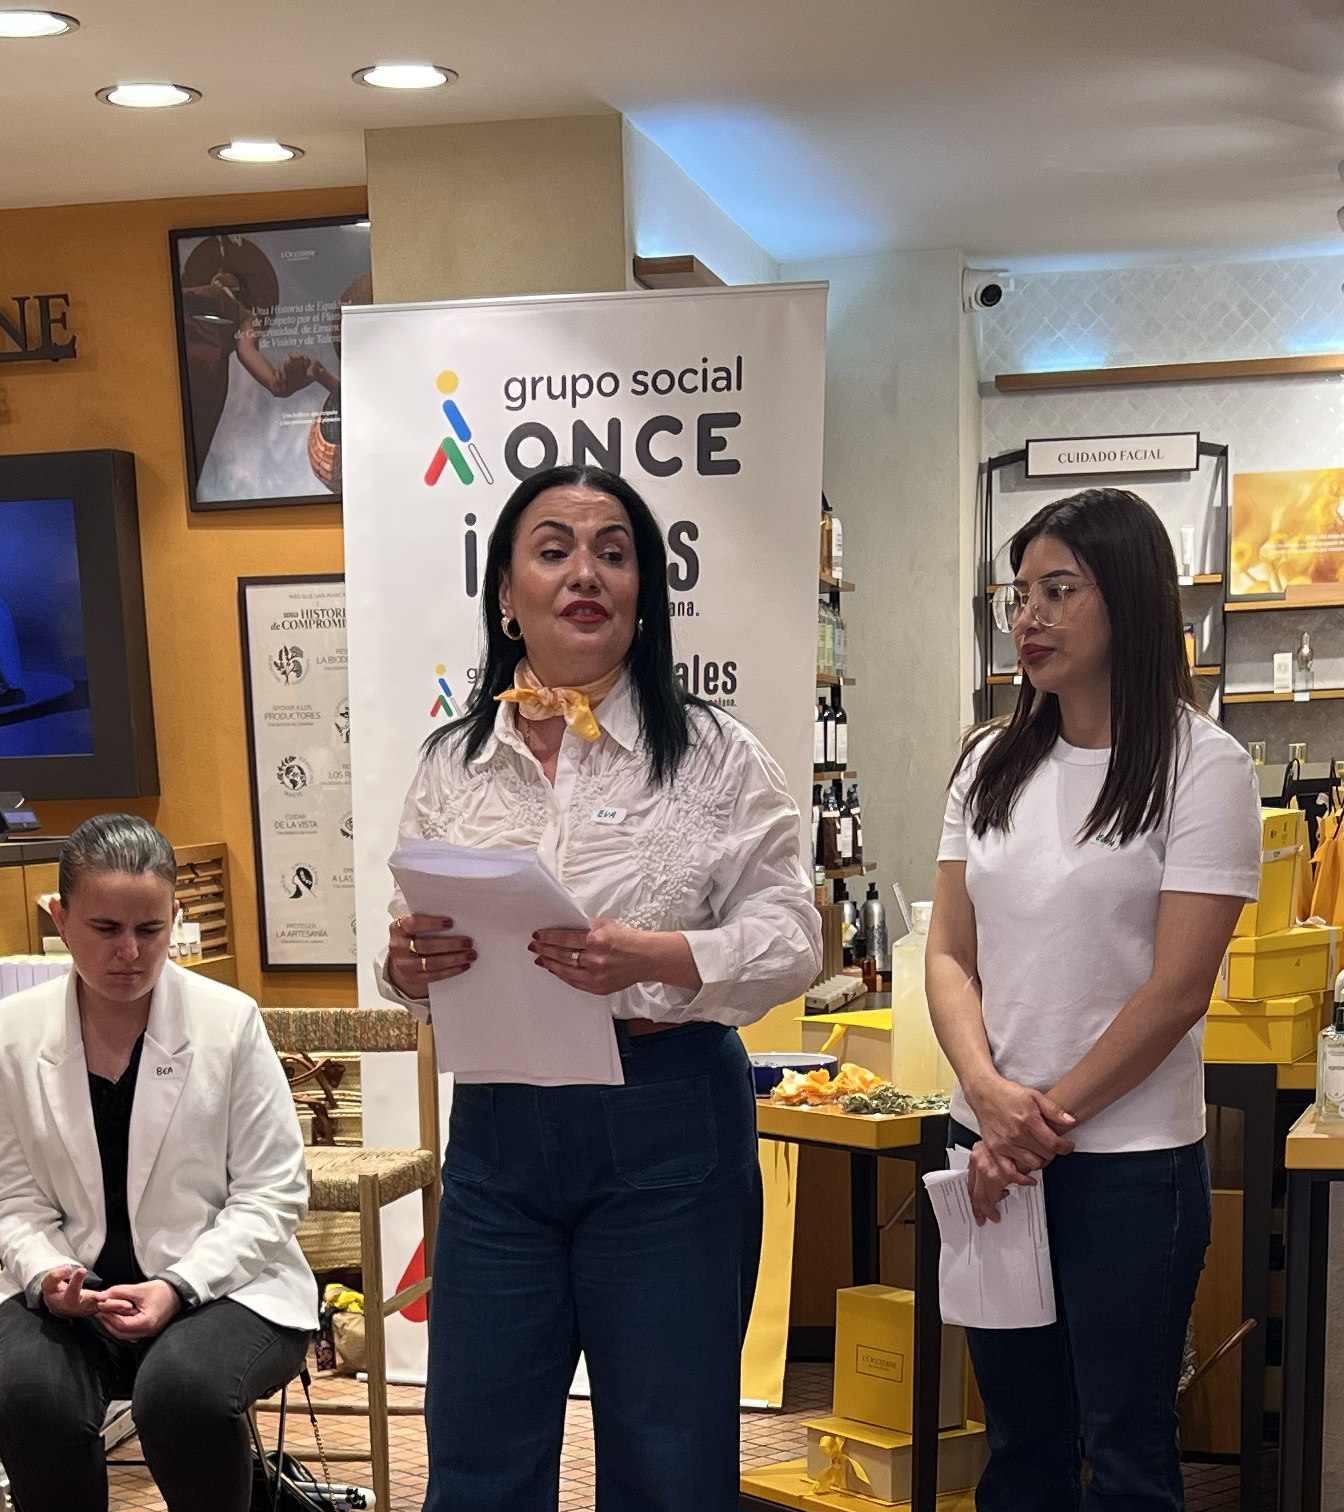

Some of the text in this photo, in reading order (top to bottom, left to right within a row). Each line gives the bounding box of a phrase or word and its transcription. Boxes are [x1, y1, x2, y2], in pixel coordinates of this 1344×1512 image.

[504, 355, 742, 411] grupo social
[504, 412, 742, 482] ONCE
[1058, 449, 1164, 464] CUIDADO FACIAL
[301, 607, 346, 619] HISTORI
[281, 617, 347, 631] COMPROMI
[264, 712, 321, 720] PRODUCTORES
[274, 820, 318, 829] DE LA VISTA
